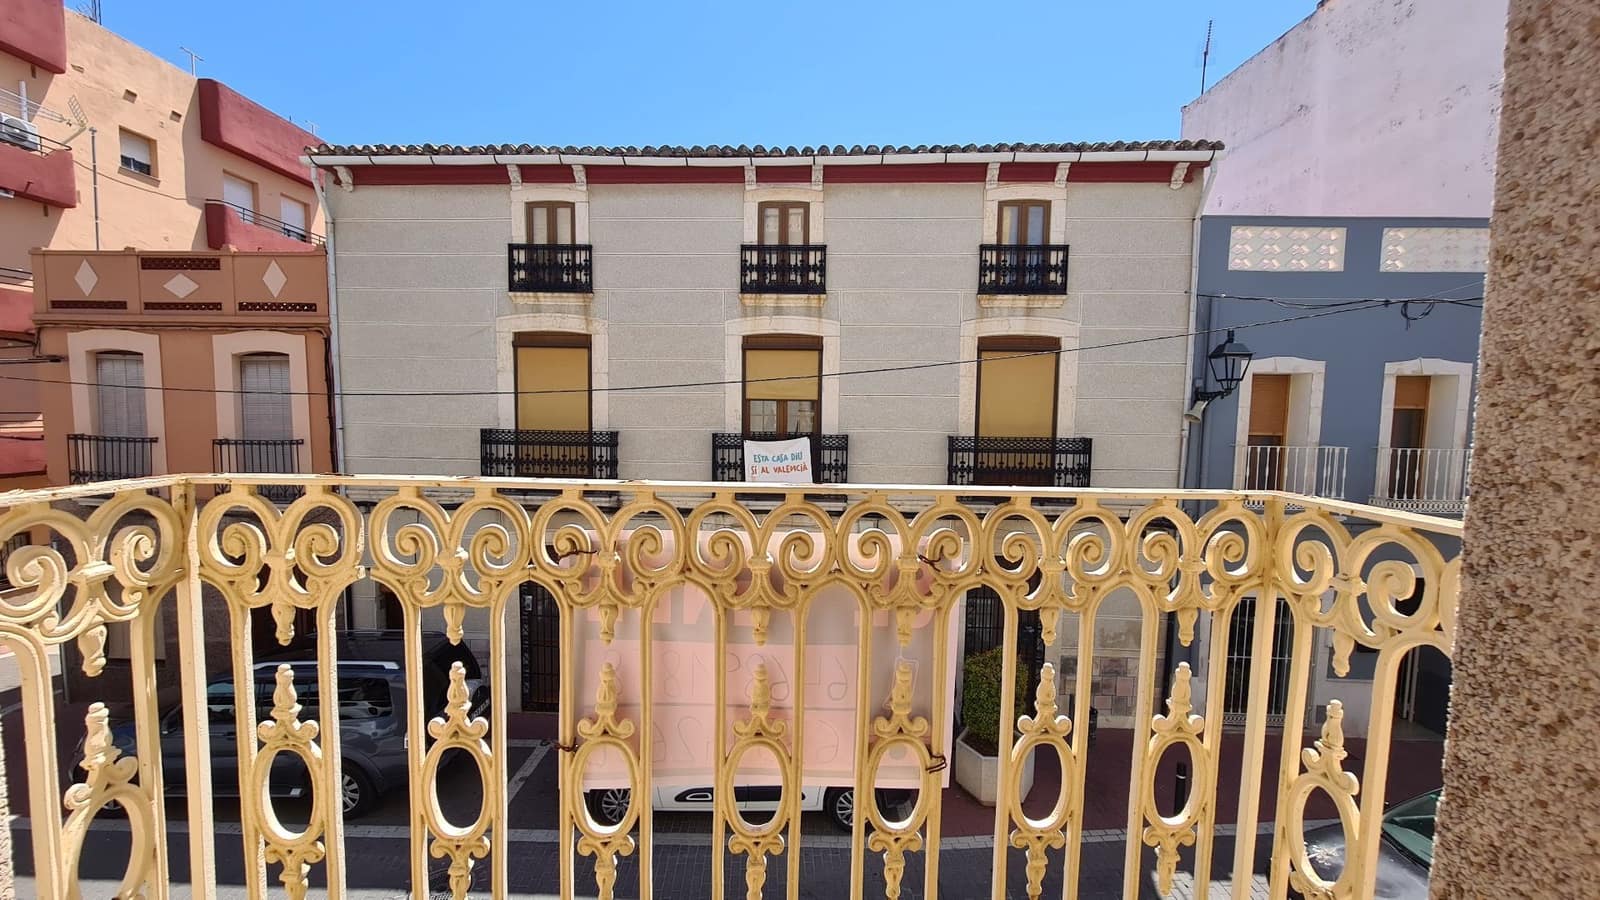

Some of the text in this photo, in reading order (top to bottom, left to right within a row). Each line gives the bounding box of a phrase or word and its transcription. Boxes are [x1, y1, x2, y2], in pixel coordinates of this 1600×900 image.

[753, 454, 769, 463] ESTA
[771, 453, 788, 463] CASA
[761, 466, 770, 474] AL
